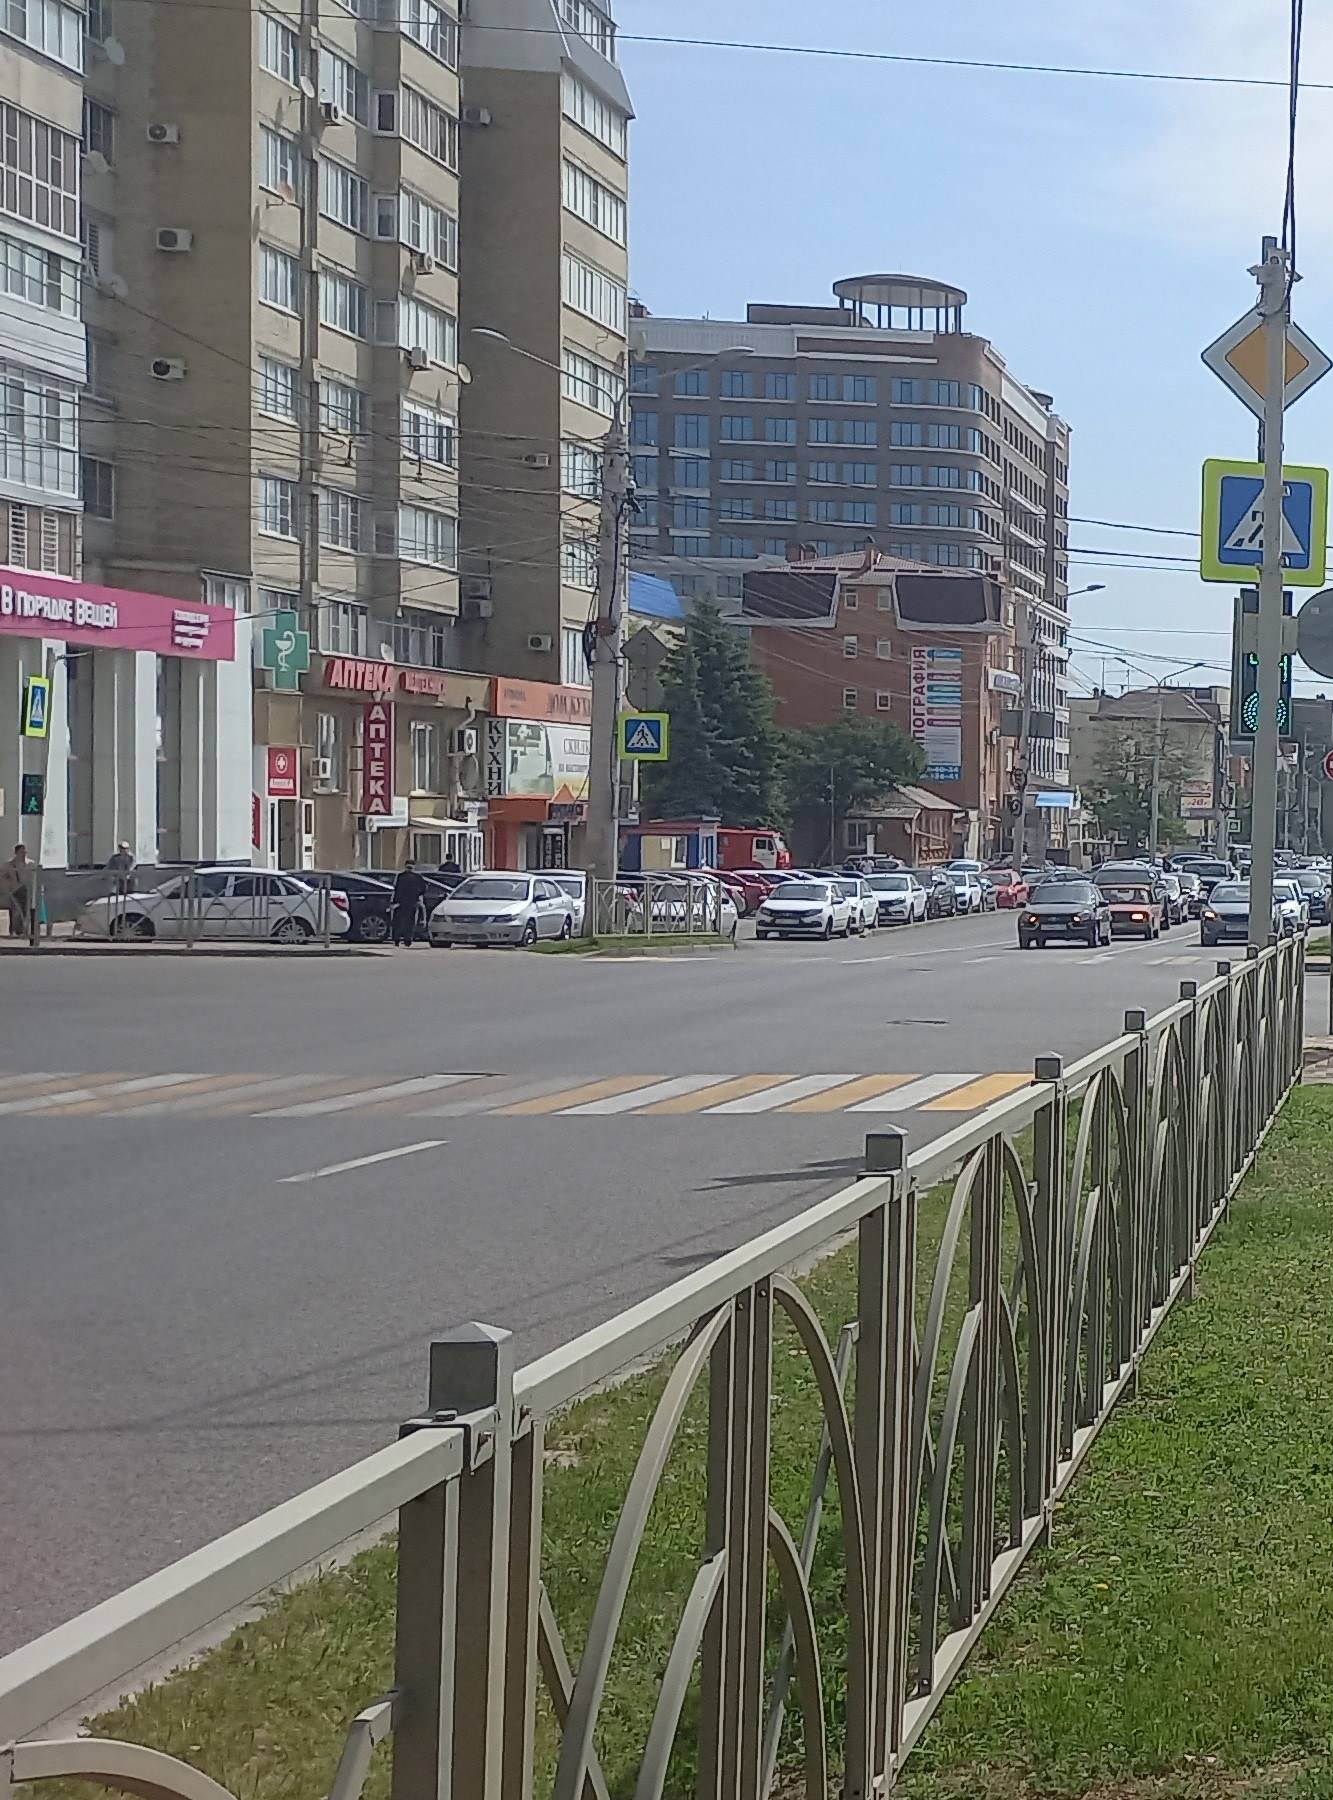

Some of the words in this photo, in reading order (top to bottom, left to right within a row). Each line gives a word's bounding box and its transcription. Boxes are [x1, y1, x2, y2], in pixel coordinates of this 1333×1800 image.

[1, 584, 13, 615] В
[329, 659, 394, 692] АПТЕКА
[912, 649, 926, 740] ПОГРАФИЯ
[369, 704, 387, 813] АПТЕКА
[487, 720, 503, 796] КУХНИ
